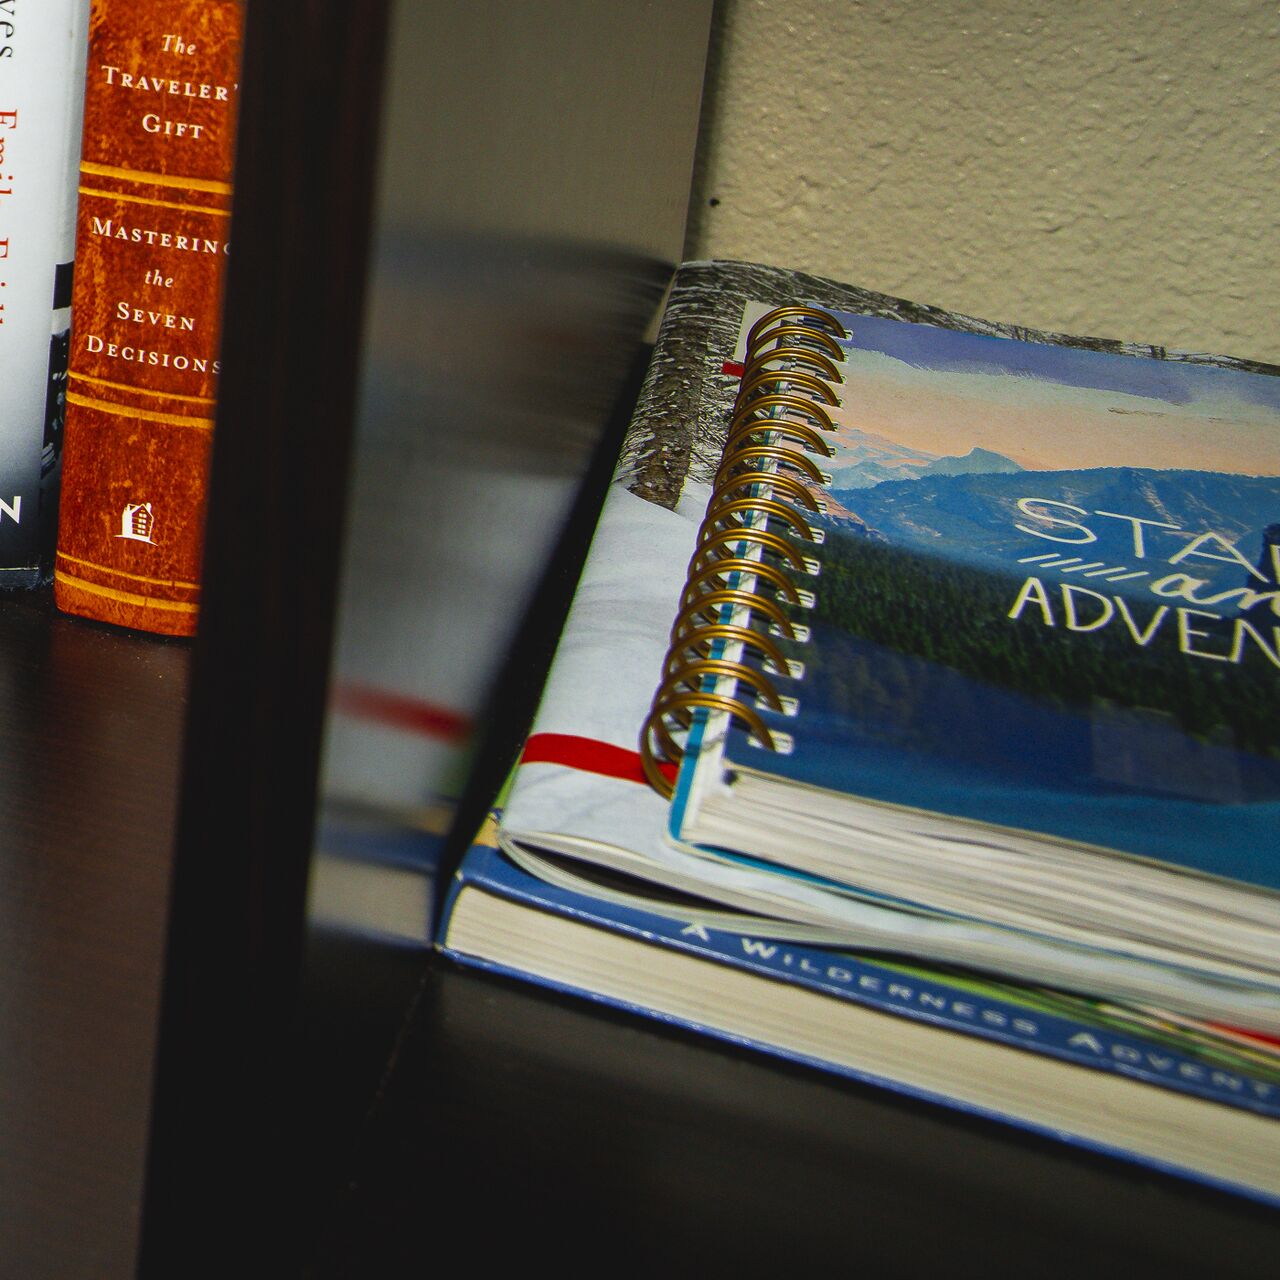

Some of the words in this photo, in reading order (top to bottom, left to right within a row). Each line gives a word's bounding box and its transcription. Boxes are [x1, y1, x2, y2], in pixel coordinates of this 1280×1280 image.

[162, 34, 197, 55] The
[142, 114, 204, 139] GIFT
[145, 269, 174, 288] the
[117, 302, 195, 331] SEVEN
[1008, 576, 1280, 668] ADVEN
[680, 921, 711, 942] A
[740, 936, 1038, 1036] WILDERNESS
